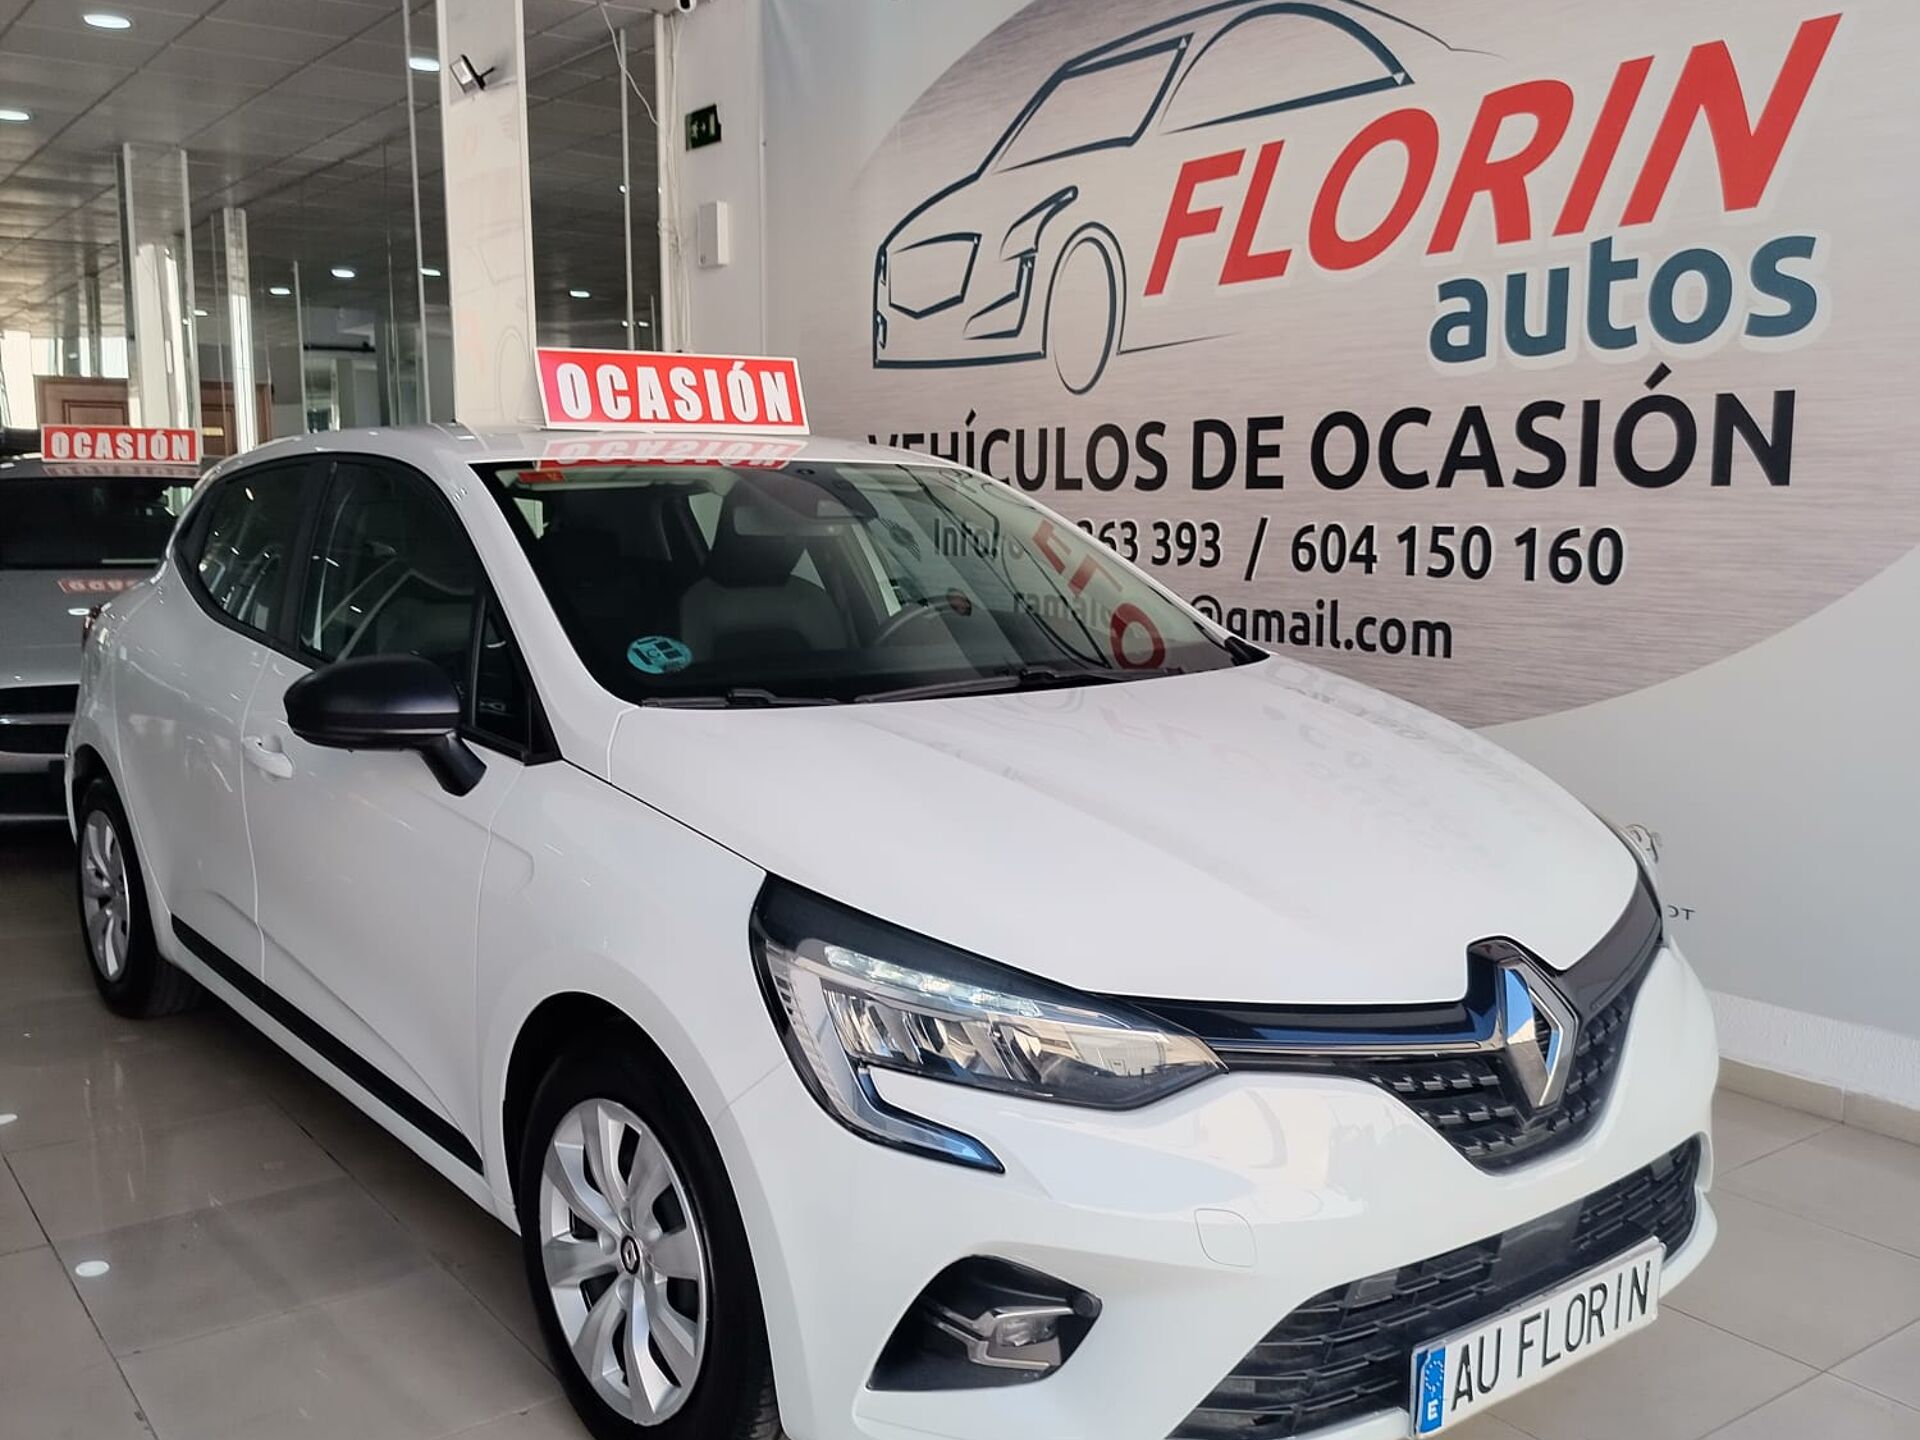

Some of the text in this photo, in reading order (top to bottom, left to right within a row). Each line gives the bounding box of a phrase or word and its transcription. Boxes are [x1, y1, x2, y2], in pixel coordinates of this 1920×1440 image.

[1143, 13, 1841, 296] FLORIN
[1430, 235, 1817, 364] autos
[555, 360, 793, 424] OCASIÓN
[868, 362, 1796, 492] HÍCULOS DE OCASIÓN
[50, 430, 190, 461] OCASIÓN
[1152, 520, 1223, 568] 393
[1244, 516, 1269, 581] /
[1291, 523, 1379, 575] 604
[1396, 524, 1493, 580] 150
[1514, 526, 1624, 585] 160
[1450, 1260, 1651, 1411] AU FLORIN
[1427, 1399, 1438, 1420] E
